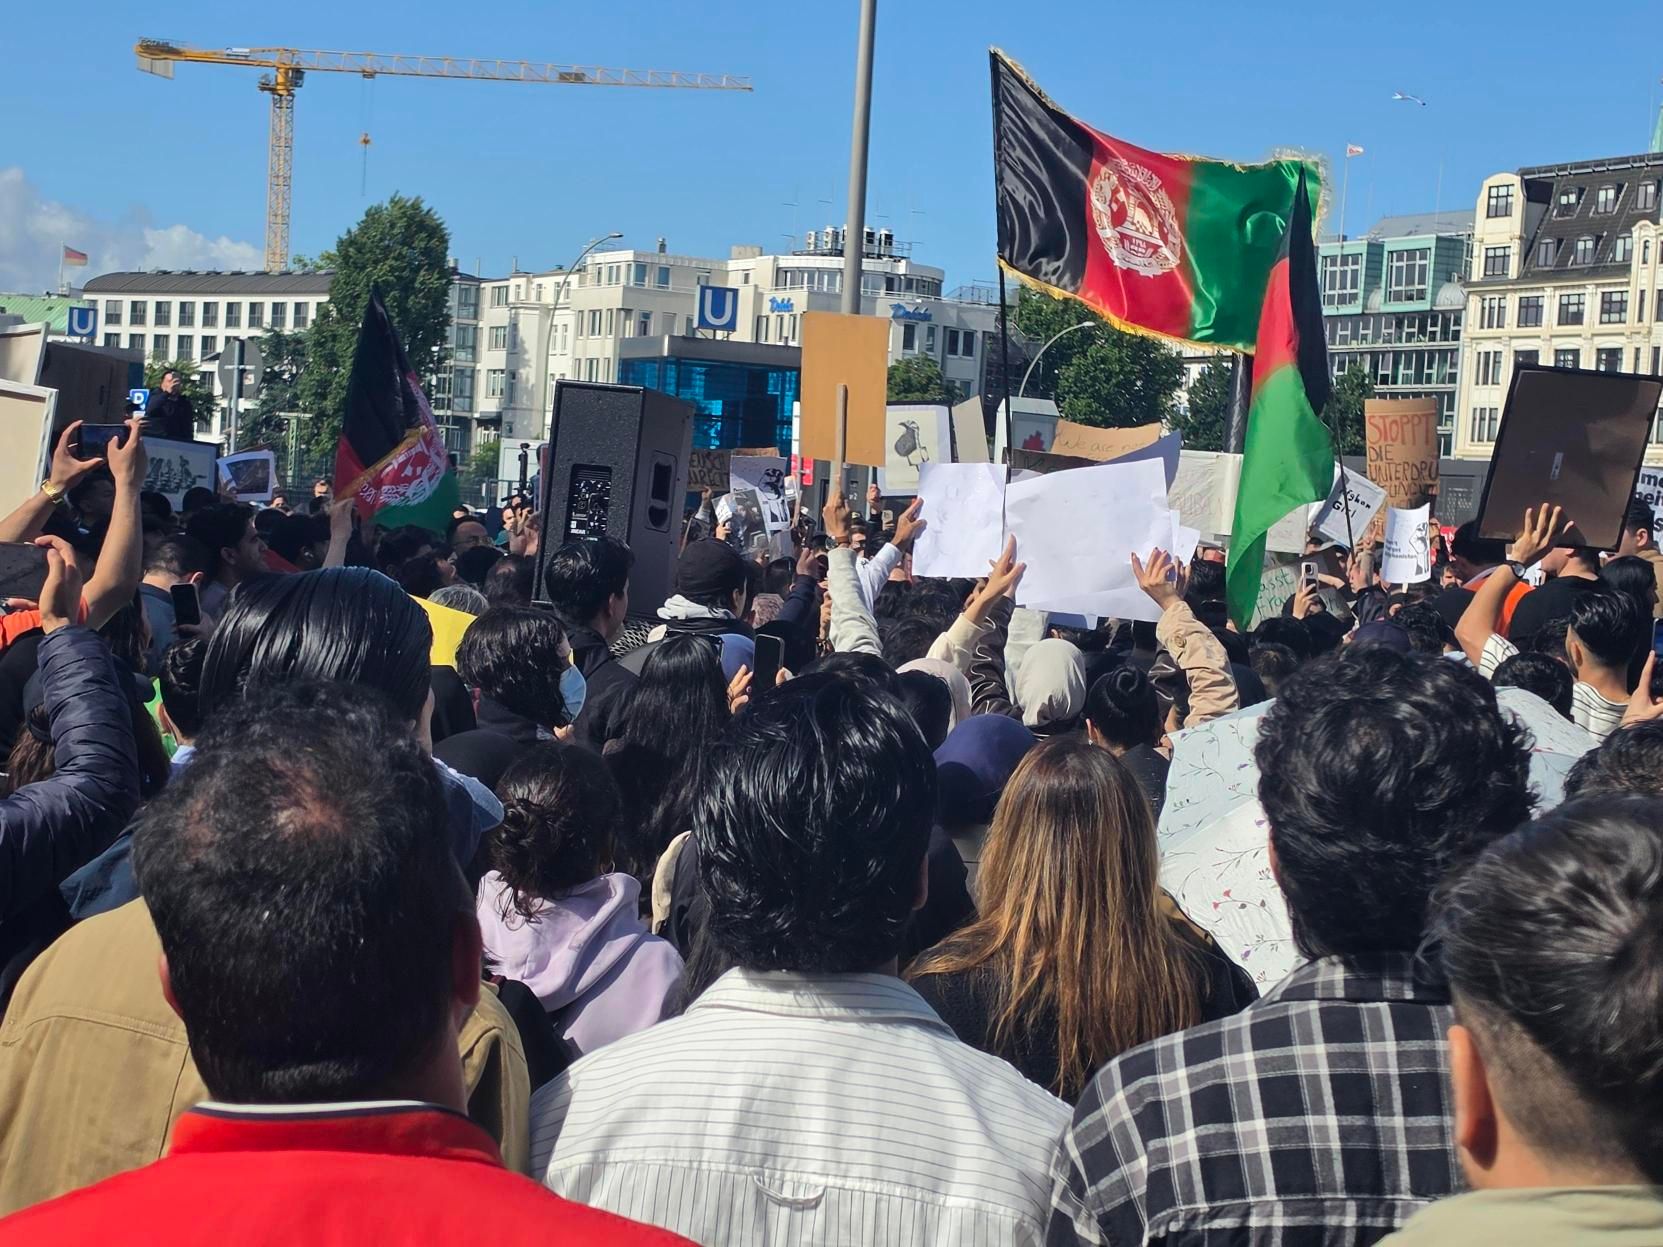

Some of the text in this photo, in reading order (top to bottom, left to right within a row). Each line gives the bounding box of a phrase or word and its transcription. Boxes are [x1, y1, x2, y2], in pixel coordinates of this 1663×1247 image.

[73, 309, 94, 335] U
[704, 289, 734, 326] U
[1367, 413, 1432, 446] STOPPT
[1368, 444, 1393, 462] DIE
